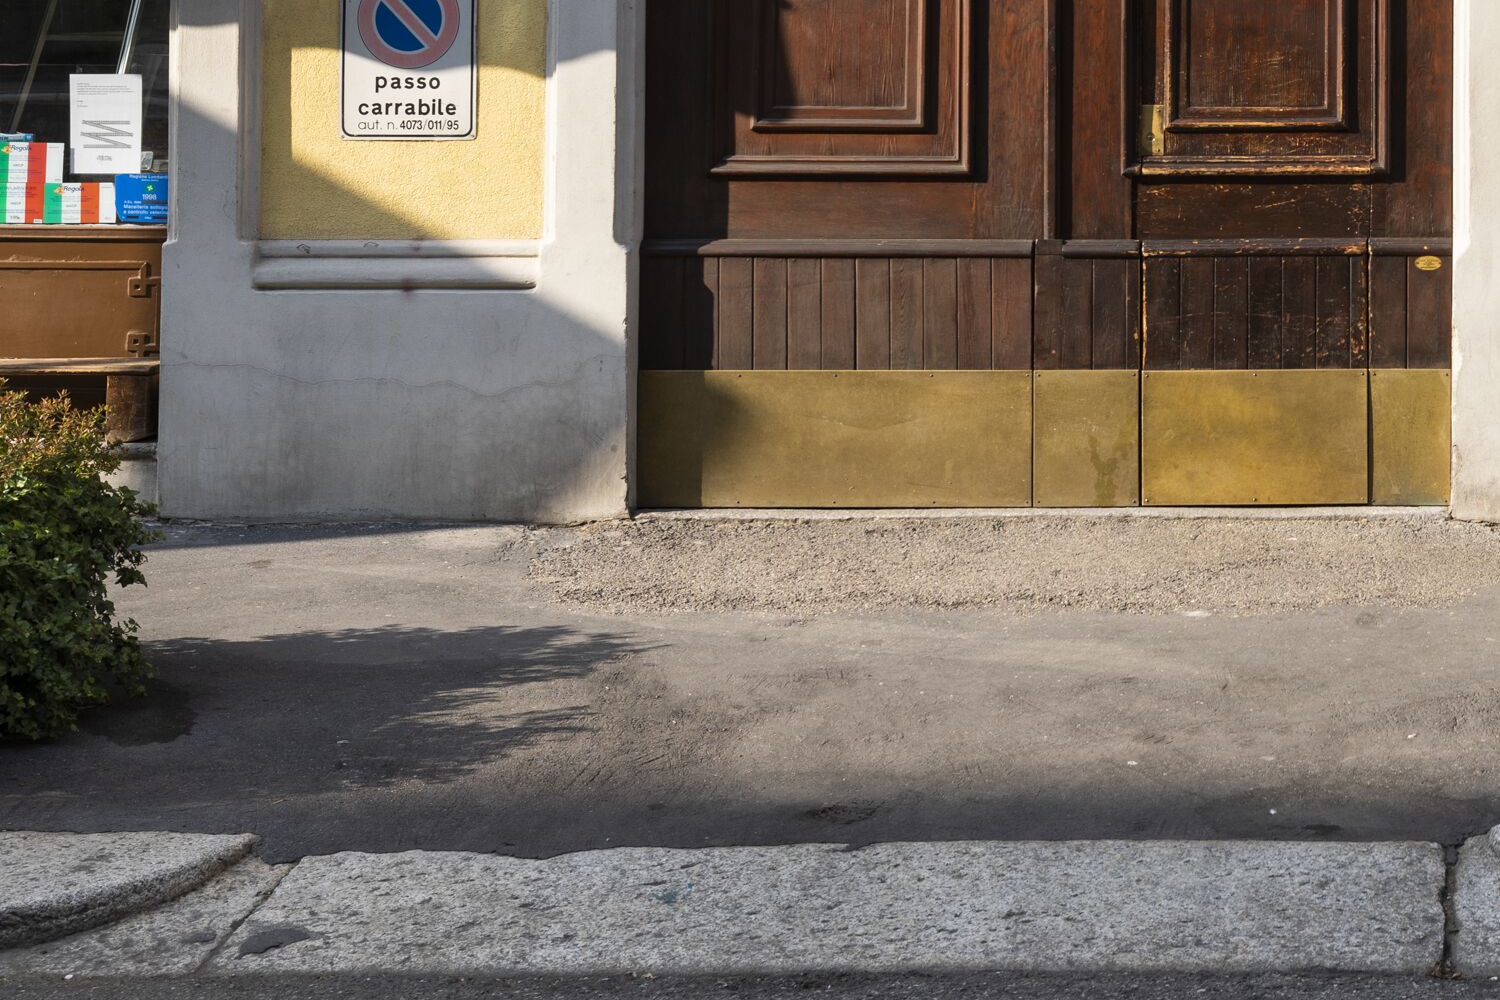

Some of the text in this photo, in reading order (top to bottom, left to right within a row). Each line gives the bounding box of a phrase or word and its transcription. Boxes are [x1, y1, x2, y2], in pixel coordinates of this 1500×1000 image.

[374, 75, 441, 93] passo
[357, 98, 457, 116] carrabile
[357, 119, 383, 131] aut.
